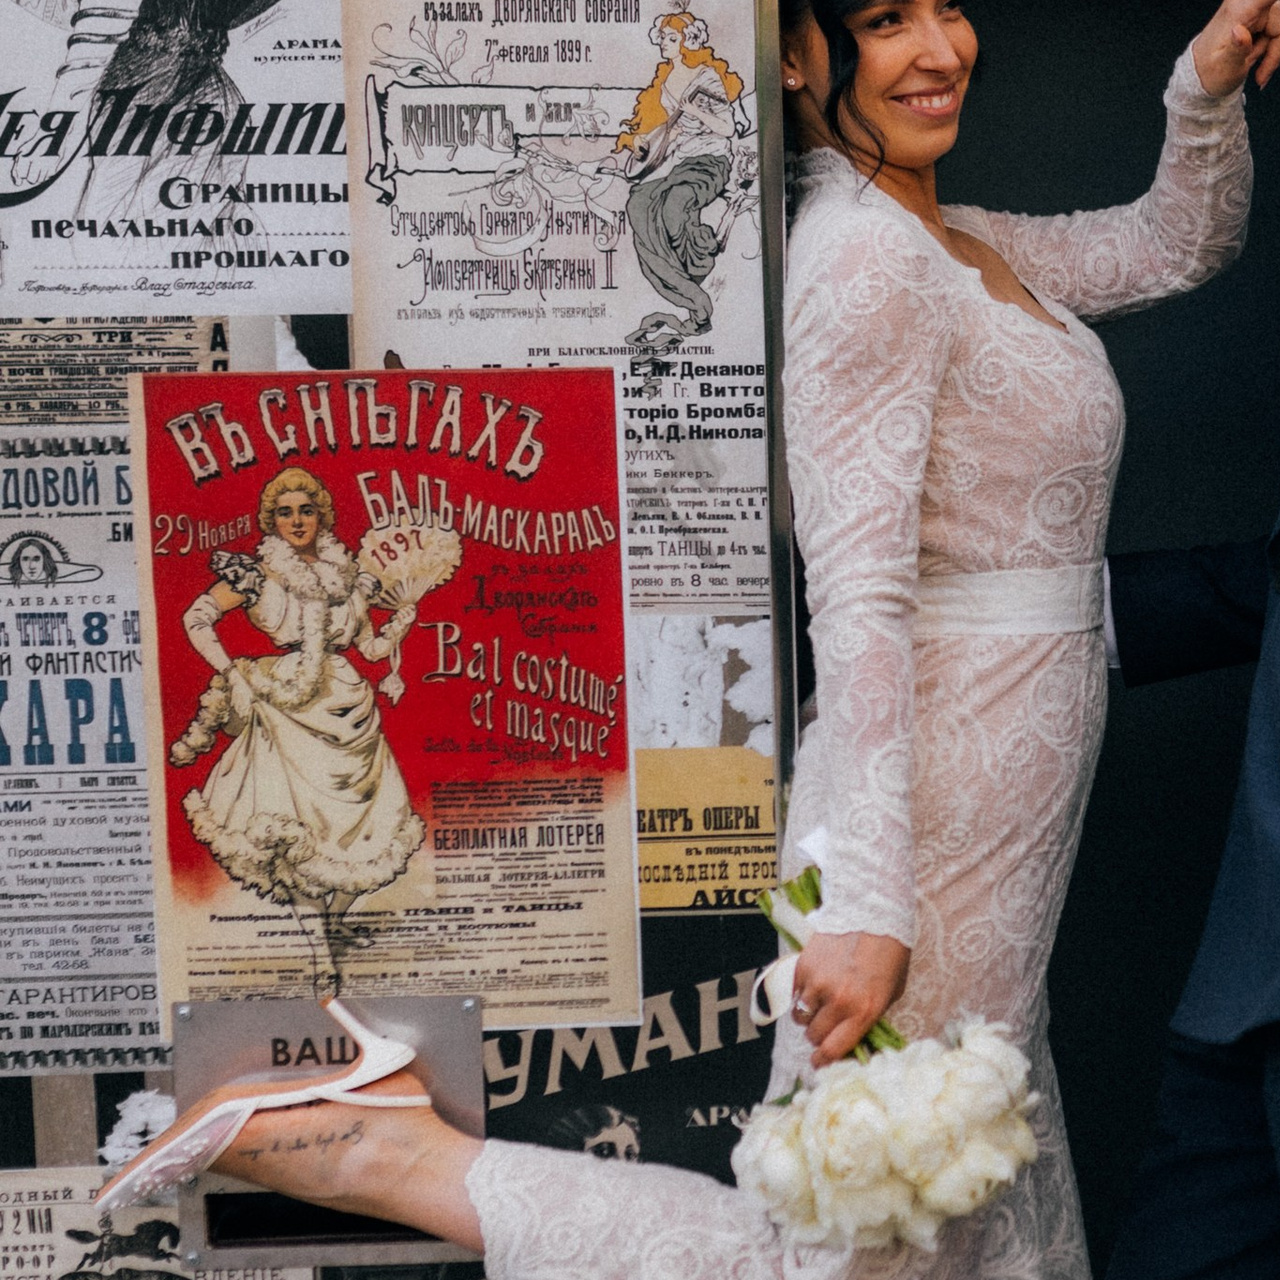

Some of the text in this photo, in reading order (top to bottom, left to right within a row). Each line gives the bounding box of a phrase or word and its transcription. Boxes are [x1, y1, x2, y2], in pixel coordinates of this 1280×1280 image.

[272, 38, 343, 51] ДРАМА
[554, 38, 582, 63] 1899
[401, 103, 515, 162] КОНЦЕРТЪ
[158, 176, 349, 210] СТРАНИЦЫ
[170, 247, 350, 269] ПРОШЛАГО
[92, 330, 133, 344] ТРИ
[528, 347, 550, 357] ПРИ
[680, 361, 765, 380] Деканов
[700, 382, 765, 398] Витто
[166, 401, 259, 488] ВЪ
[688, 425, 766, 441] Никола
[2, 460, 100, 510] ДОВОЙ
[654, 469, 715, 482] Беккеръ.
[153, 514, 196, 557] 29
[369, 528, 425, 572] 1897
[657, 540, 712, 559] ТАНЦЫ
[631, 577, 664, 589] ровно
[691, 573, 702, 587] 8
[418, 621, 625, 720] Bal costumé
[469, 688, 495, 731] et
[506, 699, 617, 763] masqué
[702, 805, 760, 831] ОПЕРЫ
[434, 823, 605, 851] БЕЗПЛАТНАЯ ЛОТЕРЕЯ
[501, 901, 584, 914] ТАНЦЫ
[271, 1036, 362, 1067] ВАШ
